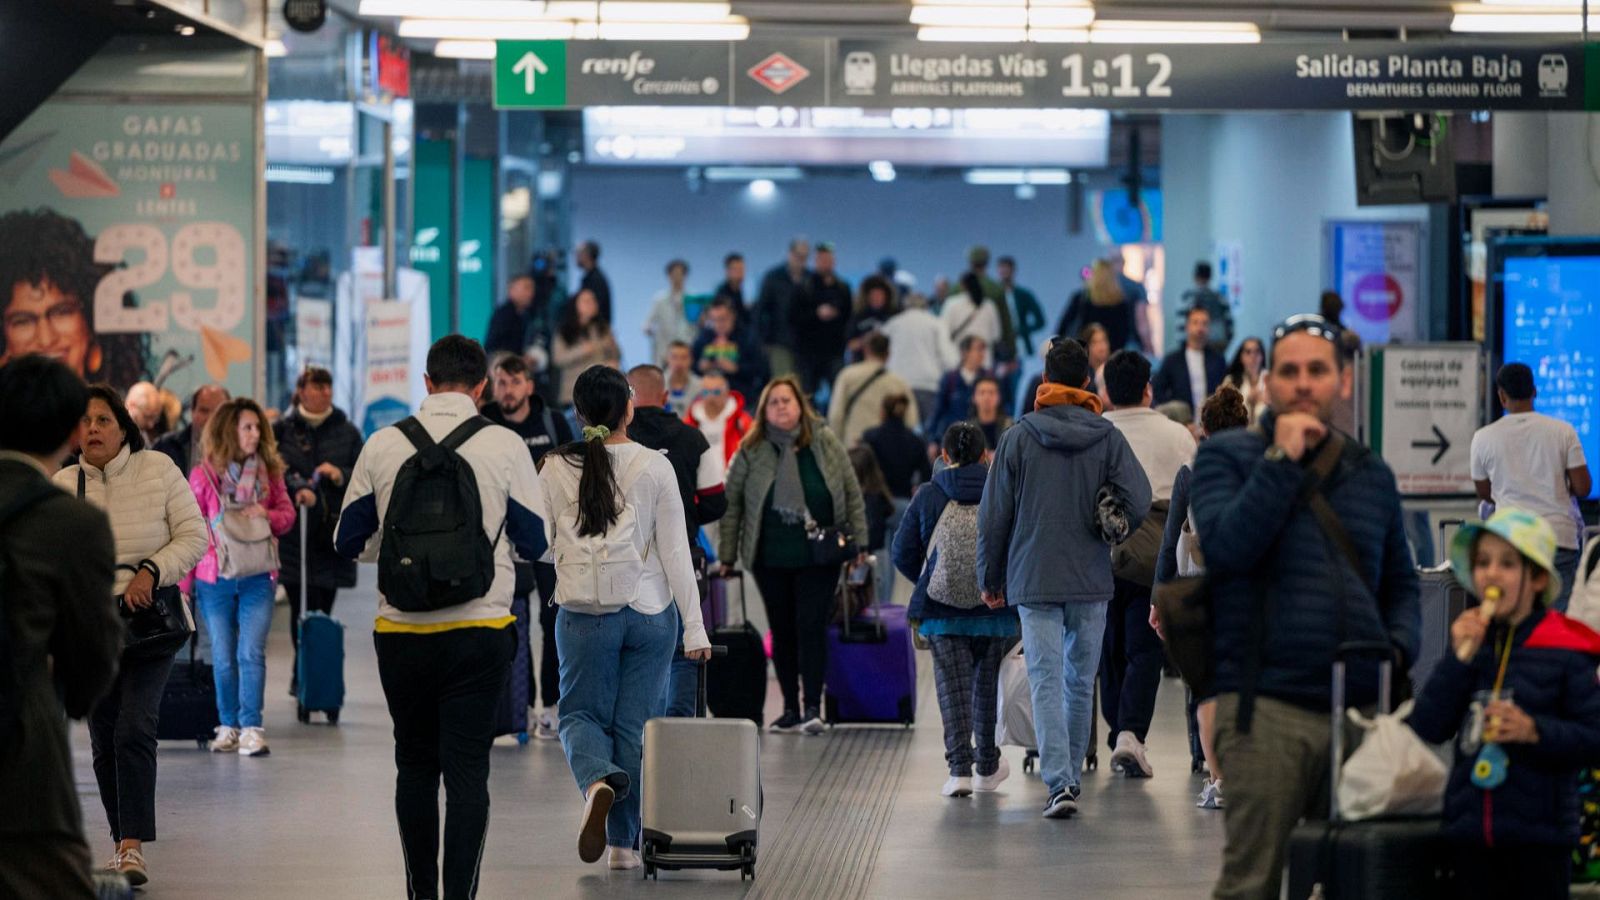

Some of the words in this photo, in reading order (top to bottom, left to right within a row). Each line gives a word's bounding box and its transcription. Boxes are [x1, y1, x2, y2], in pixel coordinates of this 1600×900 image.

[581, 50, 656, 81] renfe
[890, 54, 994, 80] Llegadas
[999, 53, 1048, 77] Vías
[1061, 53, 1091, 97] 1
[1093, 59, 1107, 78] a
[1111, 53, 1172, 97] 12
[1296, 54, 1380, 78] Salidas
[1388, 54, 1463, 78] Planta
[1472, 54, 1522, 82] Baja
[952, 81, 1024, 96] PLATFORMS
[1092, 82, 1109, 97] TO
[1346, 83, 1424, 97] DEPARTURES
[1427, 83, 1479, 97] GROUND
[1483, 82, 1521, 97] FLOOR
[123, 115, 204, 135] GAFAS
[93, 141, 241, 163] GRADUADAS
[118, 165, 217, 182] MONTURAS
[93, 221, 247, 334] 29
[1401, 358, 1445, 371] Control
[1448, 359, 1463, 372] de
[1401, 375, 1459, 390] equipajes
